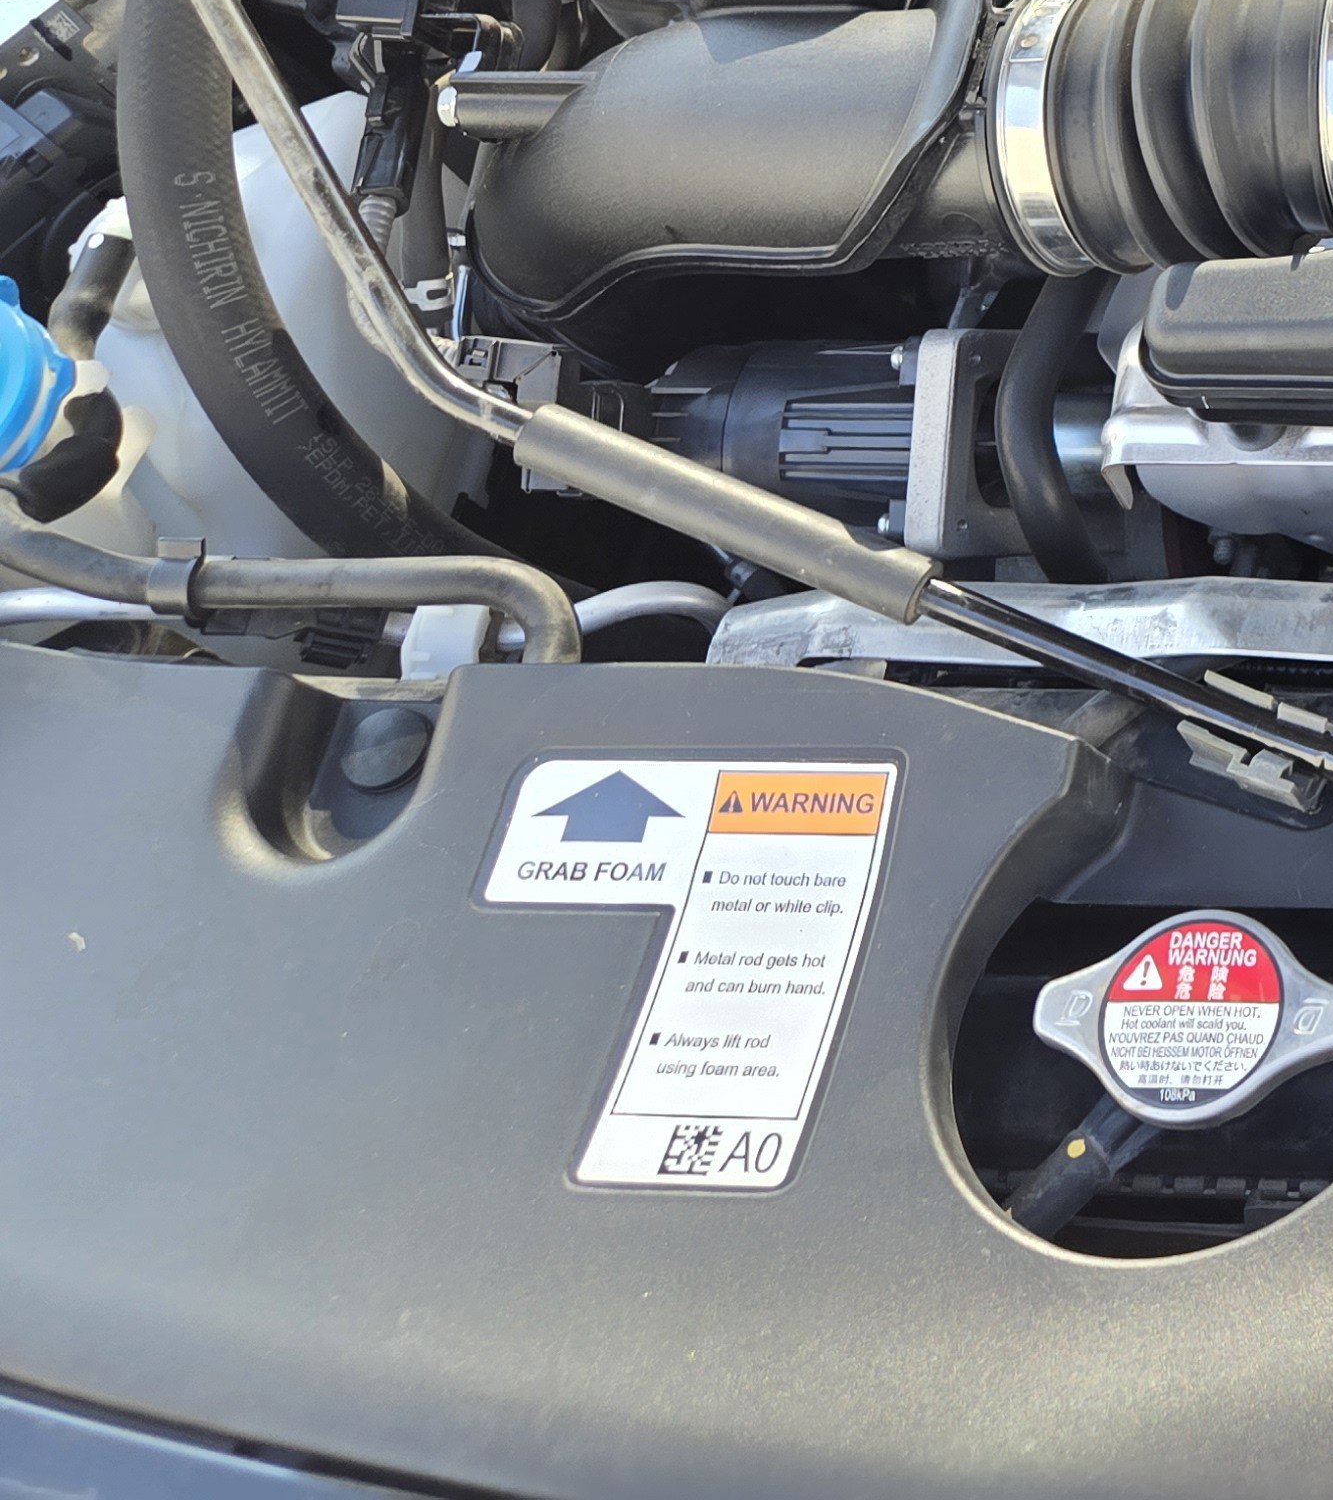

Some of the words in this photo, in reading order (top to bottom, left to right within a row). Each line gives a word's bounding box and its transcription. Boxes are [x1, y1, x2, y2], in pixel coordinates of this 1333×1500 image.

[220, 316, 309, 426] HYLAMMIT
[750, 792, 876, 815] WARNING
[517, 861, 587, 882] GRAB
[593, 862, 667, 882] FOAM
[718, 871, 740, 887] Do
[742, 872, 767, 887] not
[769, 872, 811, 888] touch
[814, 873, 847, 888] bare
[711, 899, 751, 913] metal
[755, 902, 772, 914] or
[774, 900, 813, 915] white
[815, 900, 845, 917] clip.
[1169, 931, 1244, 950] DANGER
[693, 951, 736, 967] Metal
[738, 953, 765, 967] rod
[765, 954, 798, 970] gets
[802, 954, 826, 969] hot
[1167, 948, 1258, 967] WARNUNG
[684, 979, 716, 993] and
[717, 981, 746, 993] can
[747, 980, 782, 994] burn
[784, 981, 827, 996] hand.
[1123, 1005, 1161, 1017] NEVER
[1163, 1005, 1195, 1017] OPEN
[1198, 1006, 1232, 1018] WHEN
[1233, 1006, 1262, 1019] HOT.
[1121, 1018, 1139, 1030] Hot
[1141, 1018, 1177, 1029] coolant
[1179, 1018, 1195, 1029] will
[1196, 1019, 1224, 1030] scald
[1225, 1020, 1247, 1032] you.
[663, 1033, 720, 1051] Always
[722, 1033, 741, 1049] lift
[744, 1034, 772, 1049] rod
[1109, 1032, 1161, 1044] N'OUVREZ
[1162, 1032, 1185, 1044] PAS
[1186, 1032, 1225, 1045] QUAND
[1111, 1046, 1137, 1058] NICHT
[1137, 1046, 1151, 1058] BEI
[1152, 1046, 1190, 1058] HEISSEM
[1191, 1047, 1222, 1058] MOTOR
[656, 1060, 698, 1078] using
[699, 1061, 740, 1077] foam
[742, 1065, 781, 1078] area.
